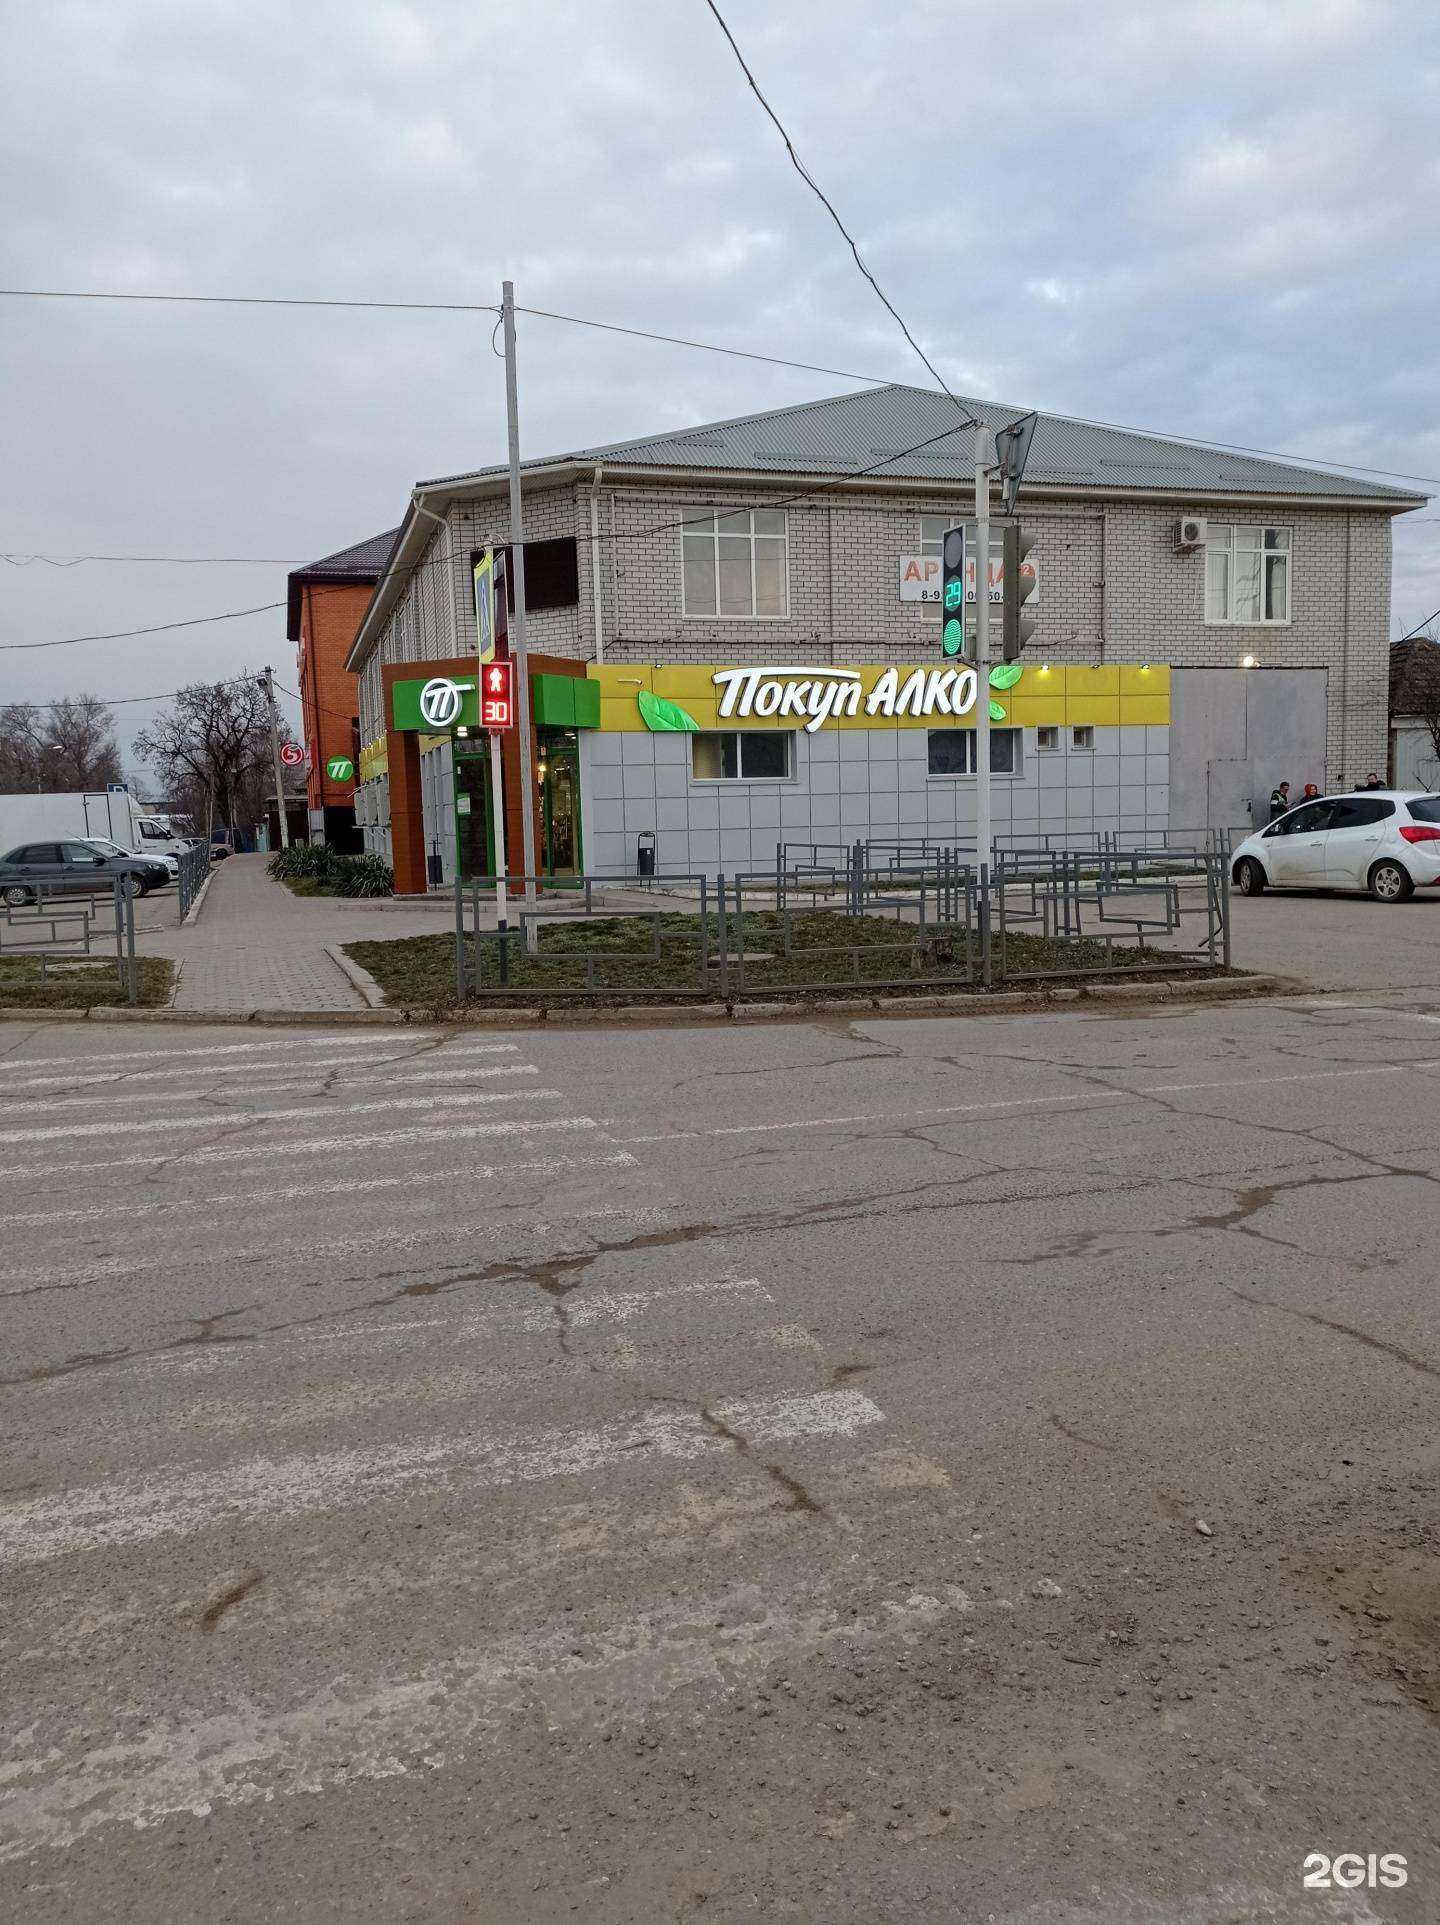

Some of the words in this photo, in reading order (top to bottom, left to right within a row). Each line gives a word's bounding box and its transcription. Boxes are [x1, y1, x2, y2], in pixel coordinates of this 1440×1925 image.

[945, 581, 961, 607] 29
[484, 701, 508, 722] 30
[712, 666, 862, 734] Покуп
[865, 667, 978, 717] АЛКО
